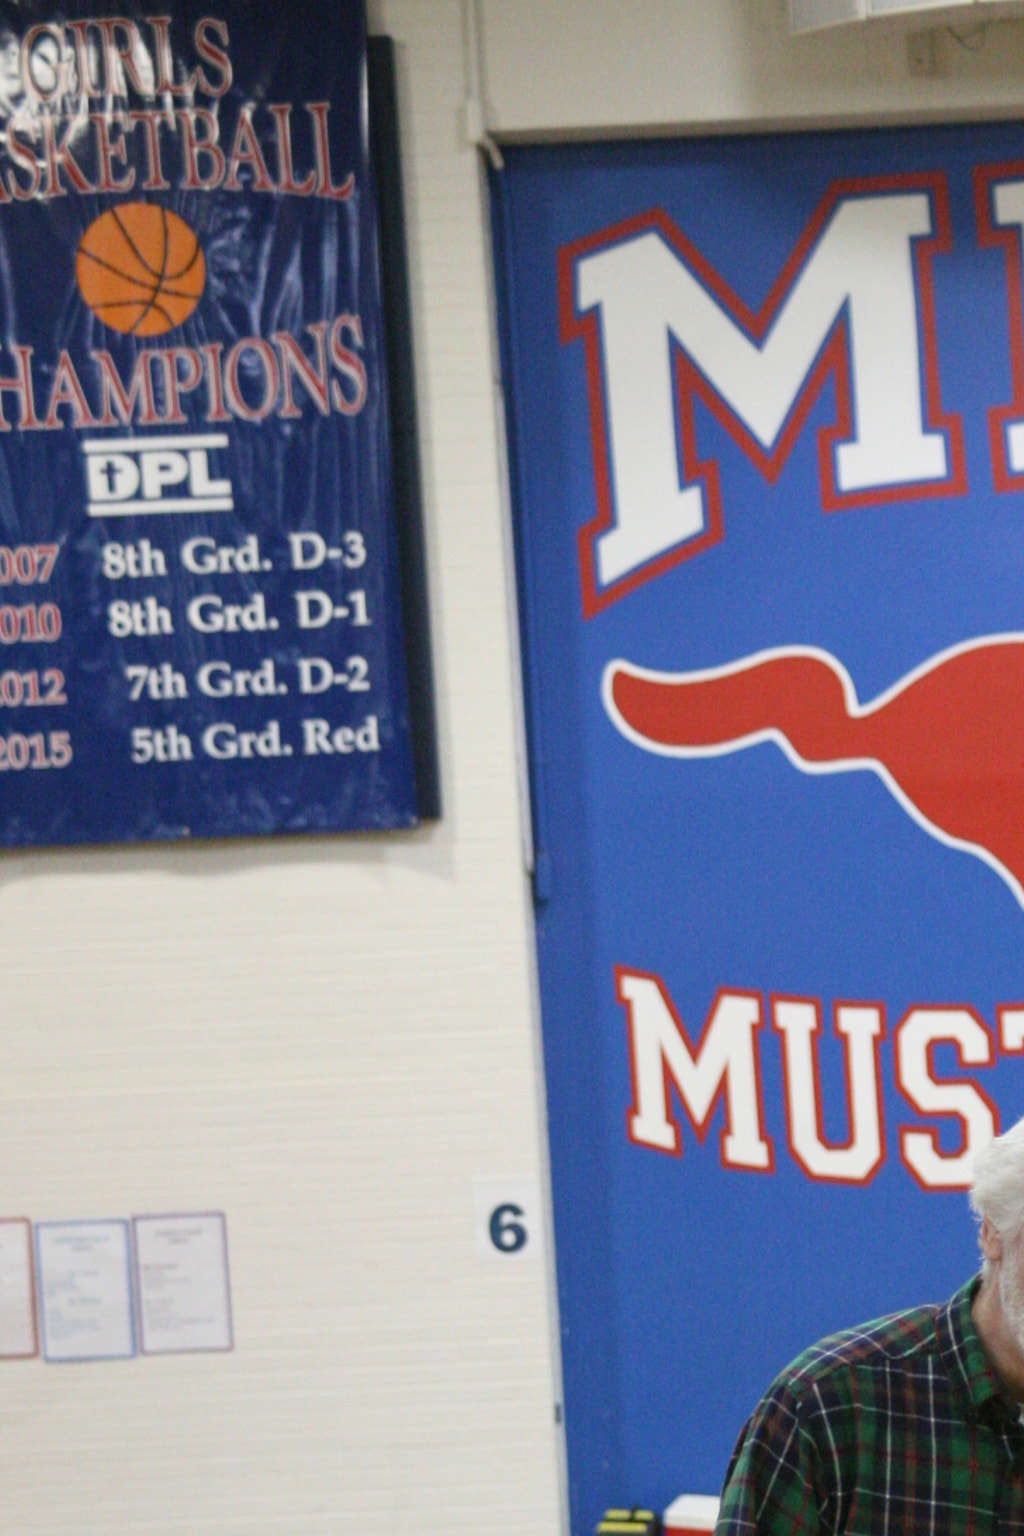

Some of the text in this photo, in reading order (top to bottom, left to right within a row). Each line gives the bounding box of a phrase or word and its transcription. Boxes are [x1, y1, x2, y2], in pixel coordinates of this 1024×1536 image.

[21, 16, 233, 99] GIRLS
[86, 449, 234, 502] DPL
[103, 538, 167, 580] 8th
[182, 534, 273, 575] Grd.
[288, 530, 367, 570] D-3
[108, 596, 174, 638] 8th
[187, 593, 280, 634] Grd.
[295, 589, 372, 630] D-1
[0, 655, 371, 707] 012 7th Grd. D-2
[131, 724, 194, 764] 5th
[203, 720, 293, 760] Grd.
[303, 715, 381, 756] Red
[487, 1202, 529, 1255] 6
